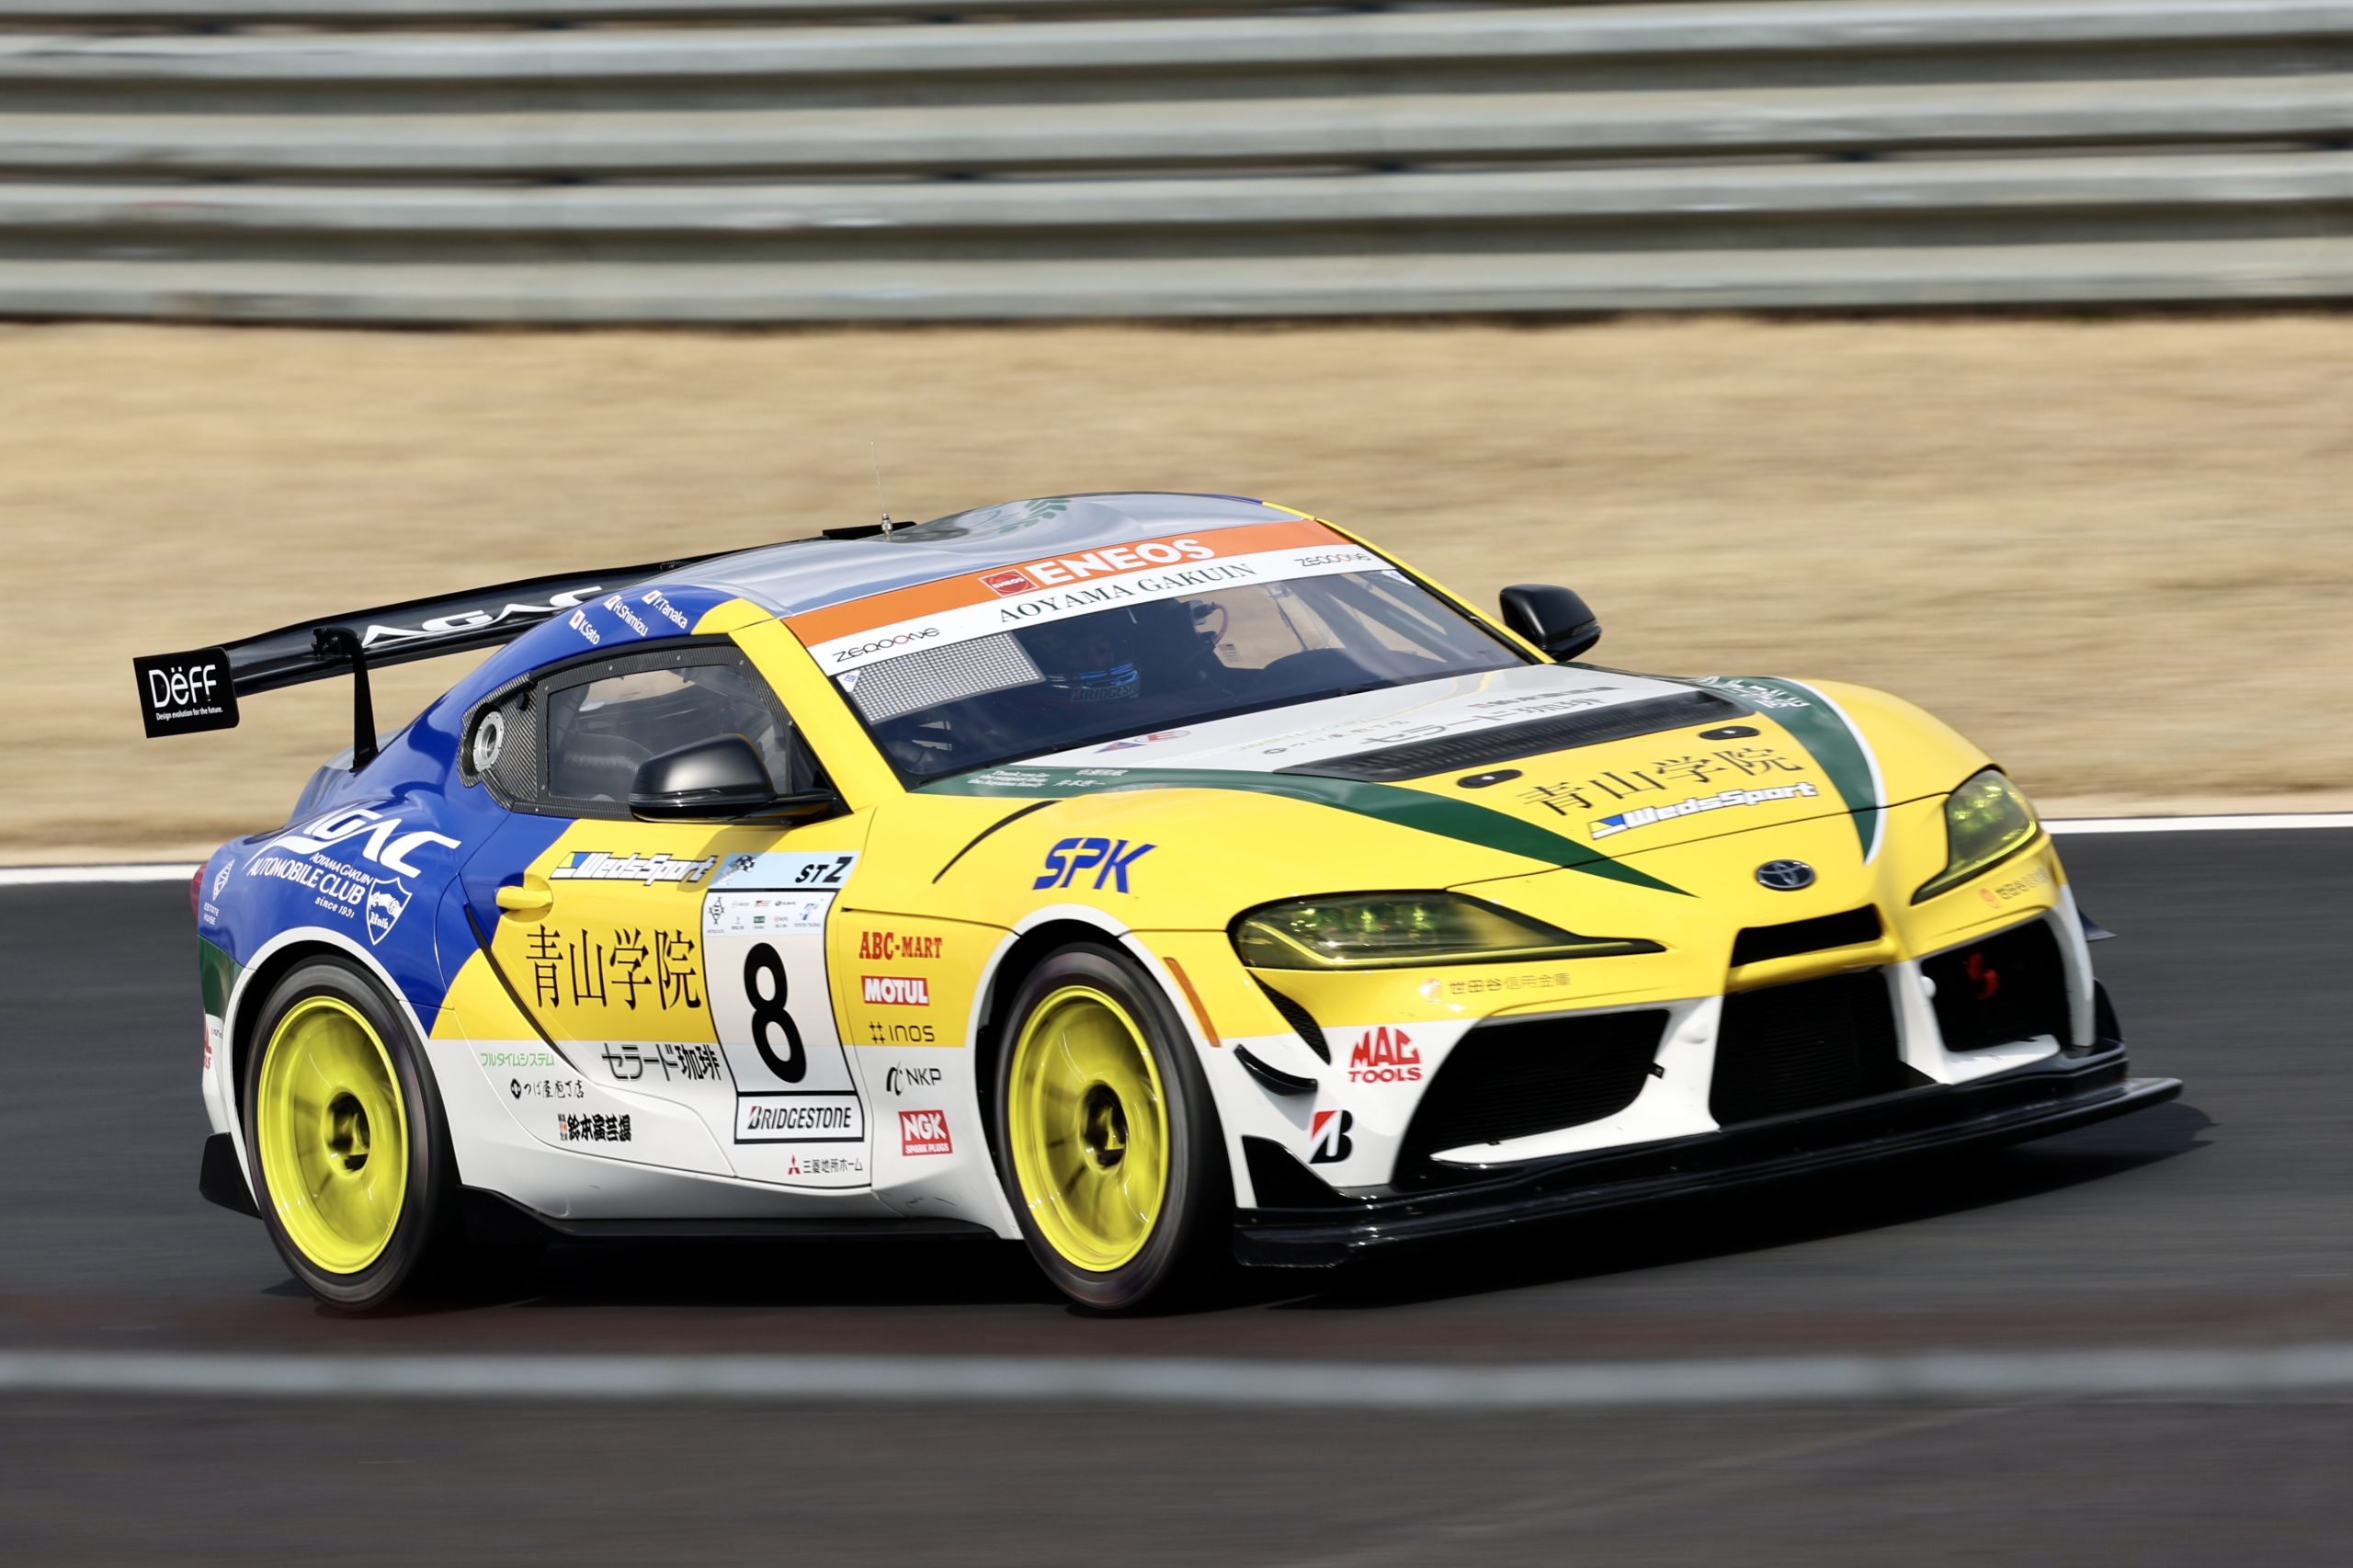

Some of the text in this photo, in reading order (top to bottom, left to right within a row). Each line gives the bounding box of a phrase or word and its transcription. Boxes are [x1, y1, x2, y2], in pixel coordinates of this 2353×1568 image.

[1024, 539, 1216, 586] ENEOS
[991, 576, 1027, 589] ENEOS
[1000, 563, 1257, 623] AOYAMA GAKUIN
[613, 601, 649, 637] H.Shimizu
[653, 596, 688, 630] Y.Tanaka
[578, 619, 600, 645] K.Sato
[155, 712, 172, 722] Design
[172, 710, 193, 719] evolution
[192, 708, 200, 716] for
[199, 707, 209, 715] the
[1516, 747, 1804, 816] 青山学院
[1620, 781, 1819, 830] WedsSport
[246, 857, 366, 905] AUTOMOBILE CLUB
[309, 852, 376, 886] AOYAMA GAKUIN
[572, 851, 719, 886] WedsSport
[1032, 836, 1158, 894] SPK
[314, 896, 355, 918] since 1931
[858, 931, 943, 960] ABC-MART
[526, 924, 702, 1010] 青山学院
[864, 978, 928, 1005] MOTUL
[744, 942, 807, 1084] 8
[480, 1052, 555, 1067] フルタイムシステム
[600, 1043, 722, 1083] セラード珈琲
[1349, 1026, 1421, 1068] MAC
[905, 1067, 942, 1086] NKP
[1347, 1066, 1423, 1084] TOOLS
[746, 1105, 852, 1131] BRIDGESTONE
[902, 1112, 948, 1142] NGK
[905, 1142, 950, 1154] SPARK PLUGS
[802, 1157, 864, 1175] 三菱地所ホーム
